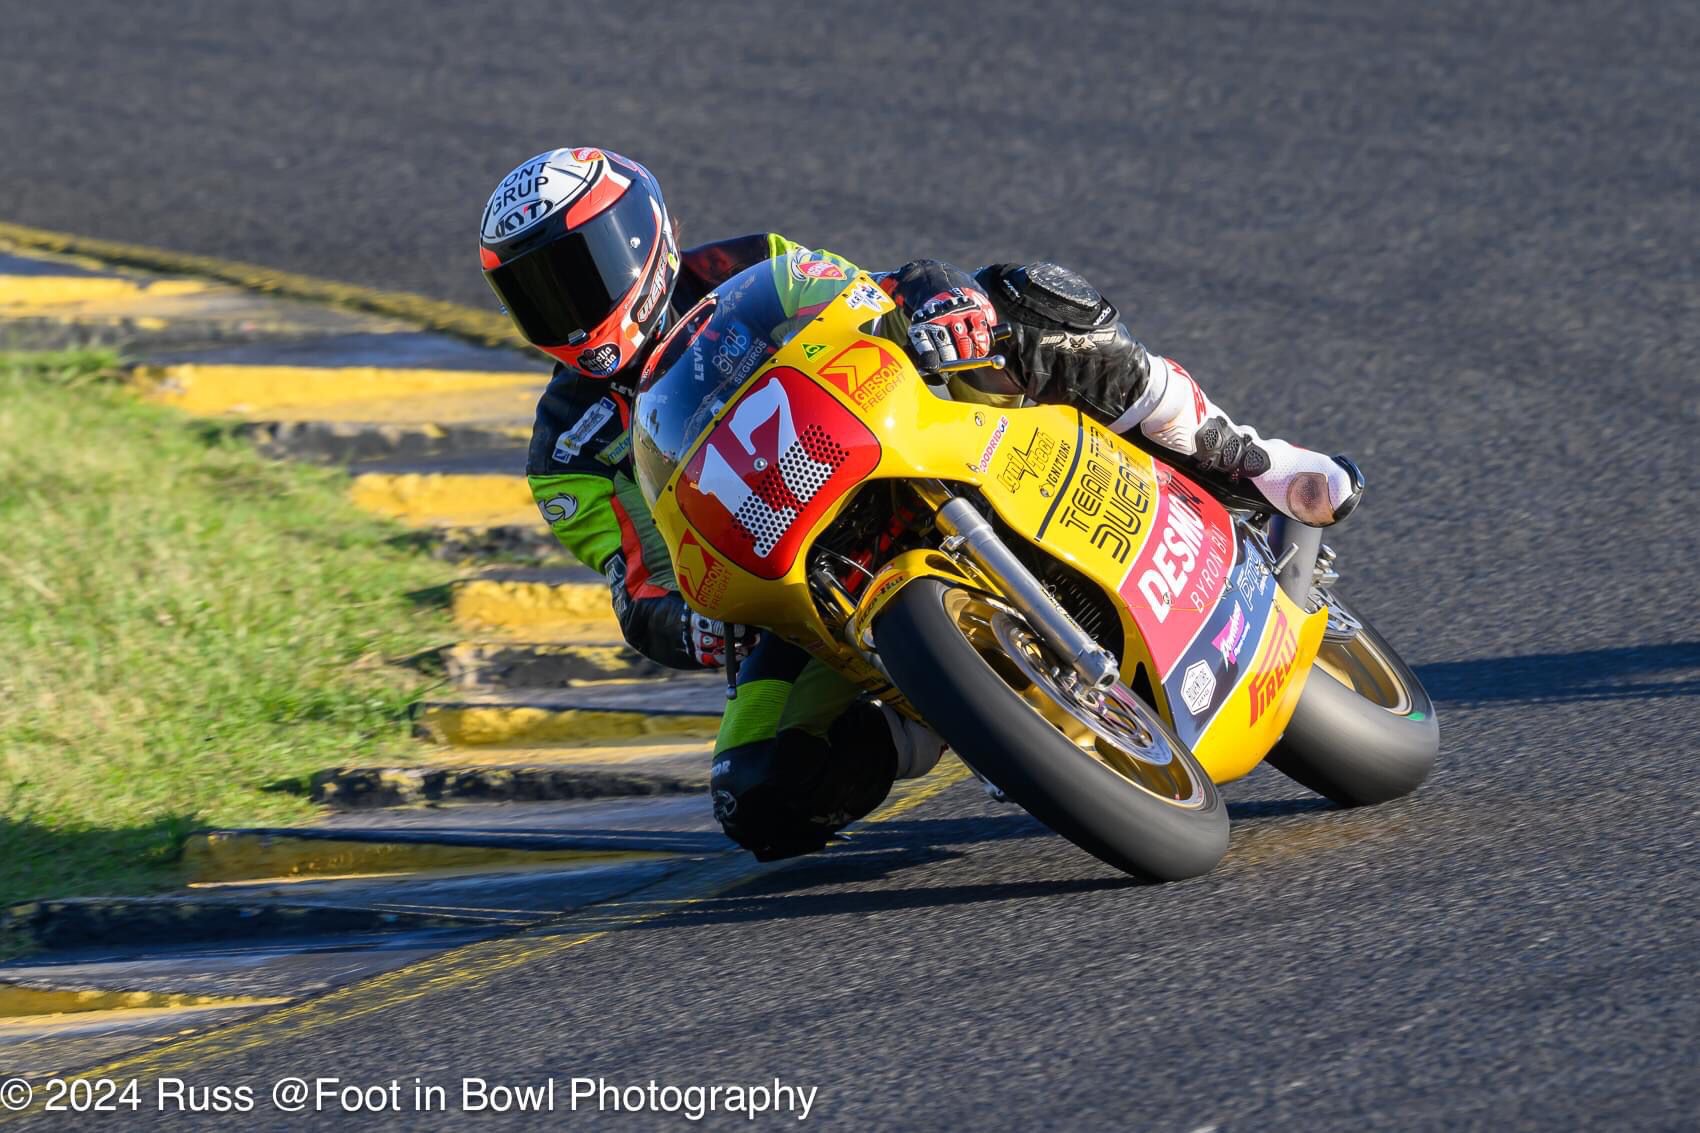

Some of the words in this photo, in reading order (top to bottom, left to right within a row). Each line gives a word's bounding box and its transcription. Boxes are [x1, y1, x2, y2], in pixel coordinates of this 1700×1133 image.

[493, 176, 549, 217] GRUP
[498, 161, 552, 190] ONT
[498, 199, 545, 236] KYT
[734, 340, 768, 385] SEGUROS
[854, 361, 902, 405] GIBSON
[861, 373, 908, 414] FREIGHT
[698, 377, 834, 558] 17
[1047, 439, 1071, 487] IGNITIONS
[1059, 459, 1112, 534] TEAM
[1138, 493, 1206, 625] DESMO
[1190, 545, 1225, 614] BYRON
[1209, 520, 1228, 556] BAY
[697, 560, 726, 608] GIBSON
[1249, 609, 1299, 728] PIRELLI
